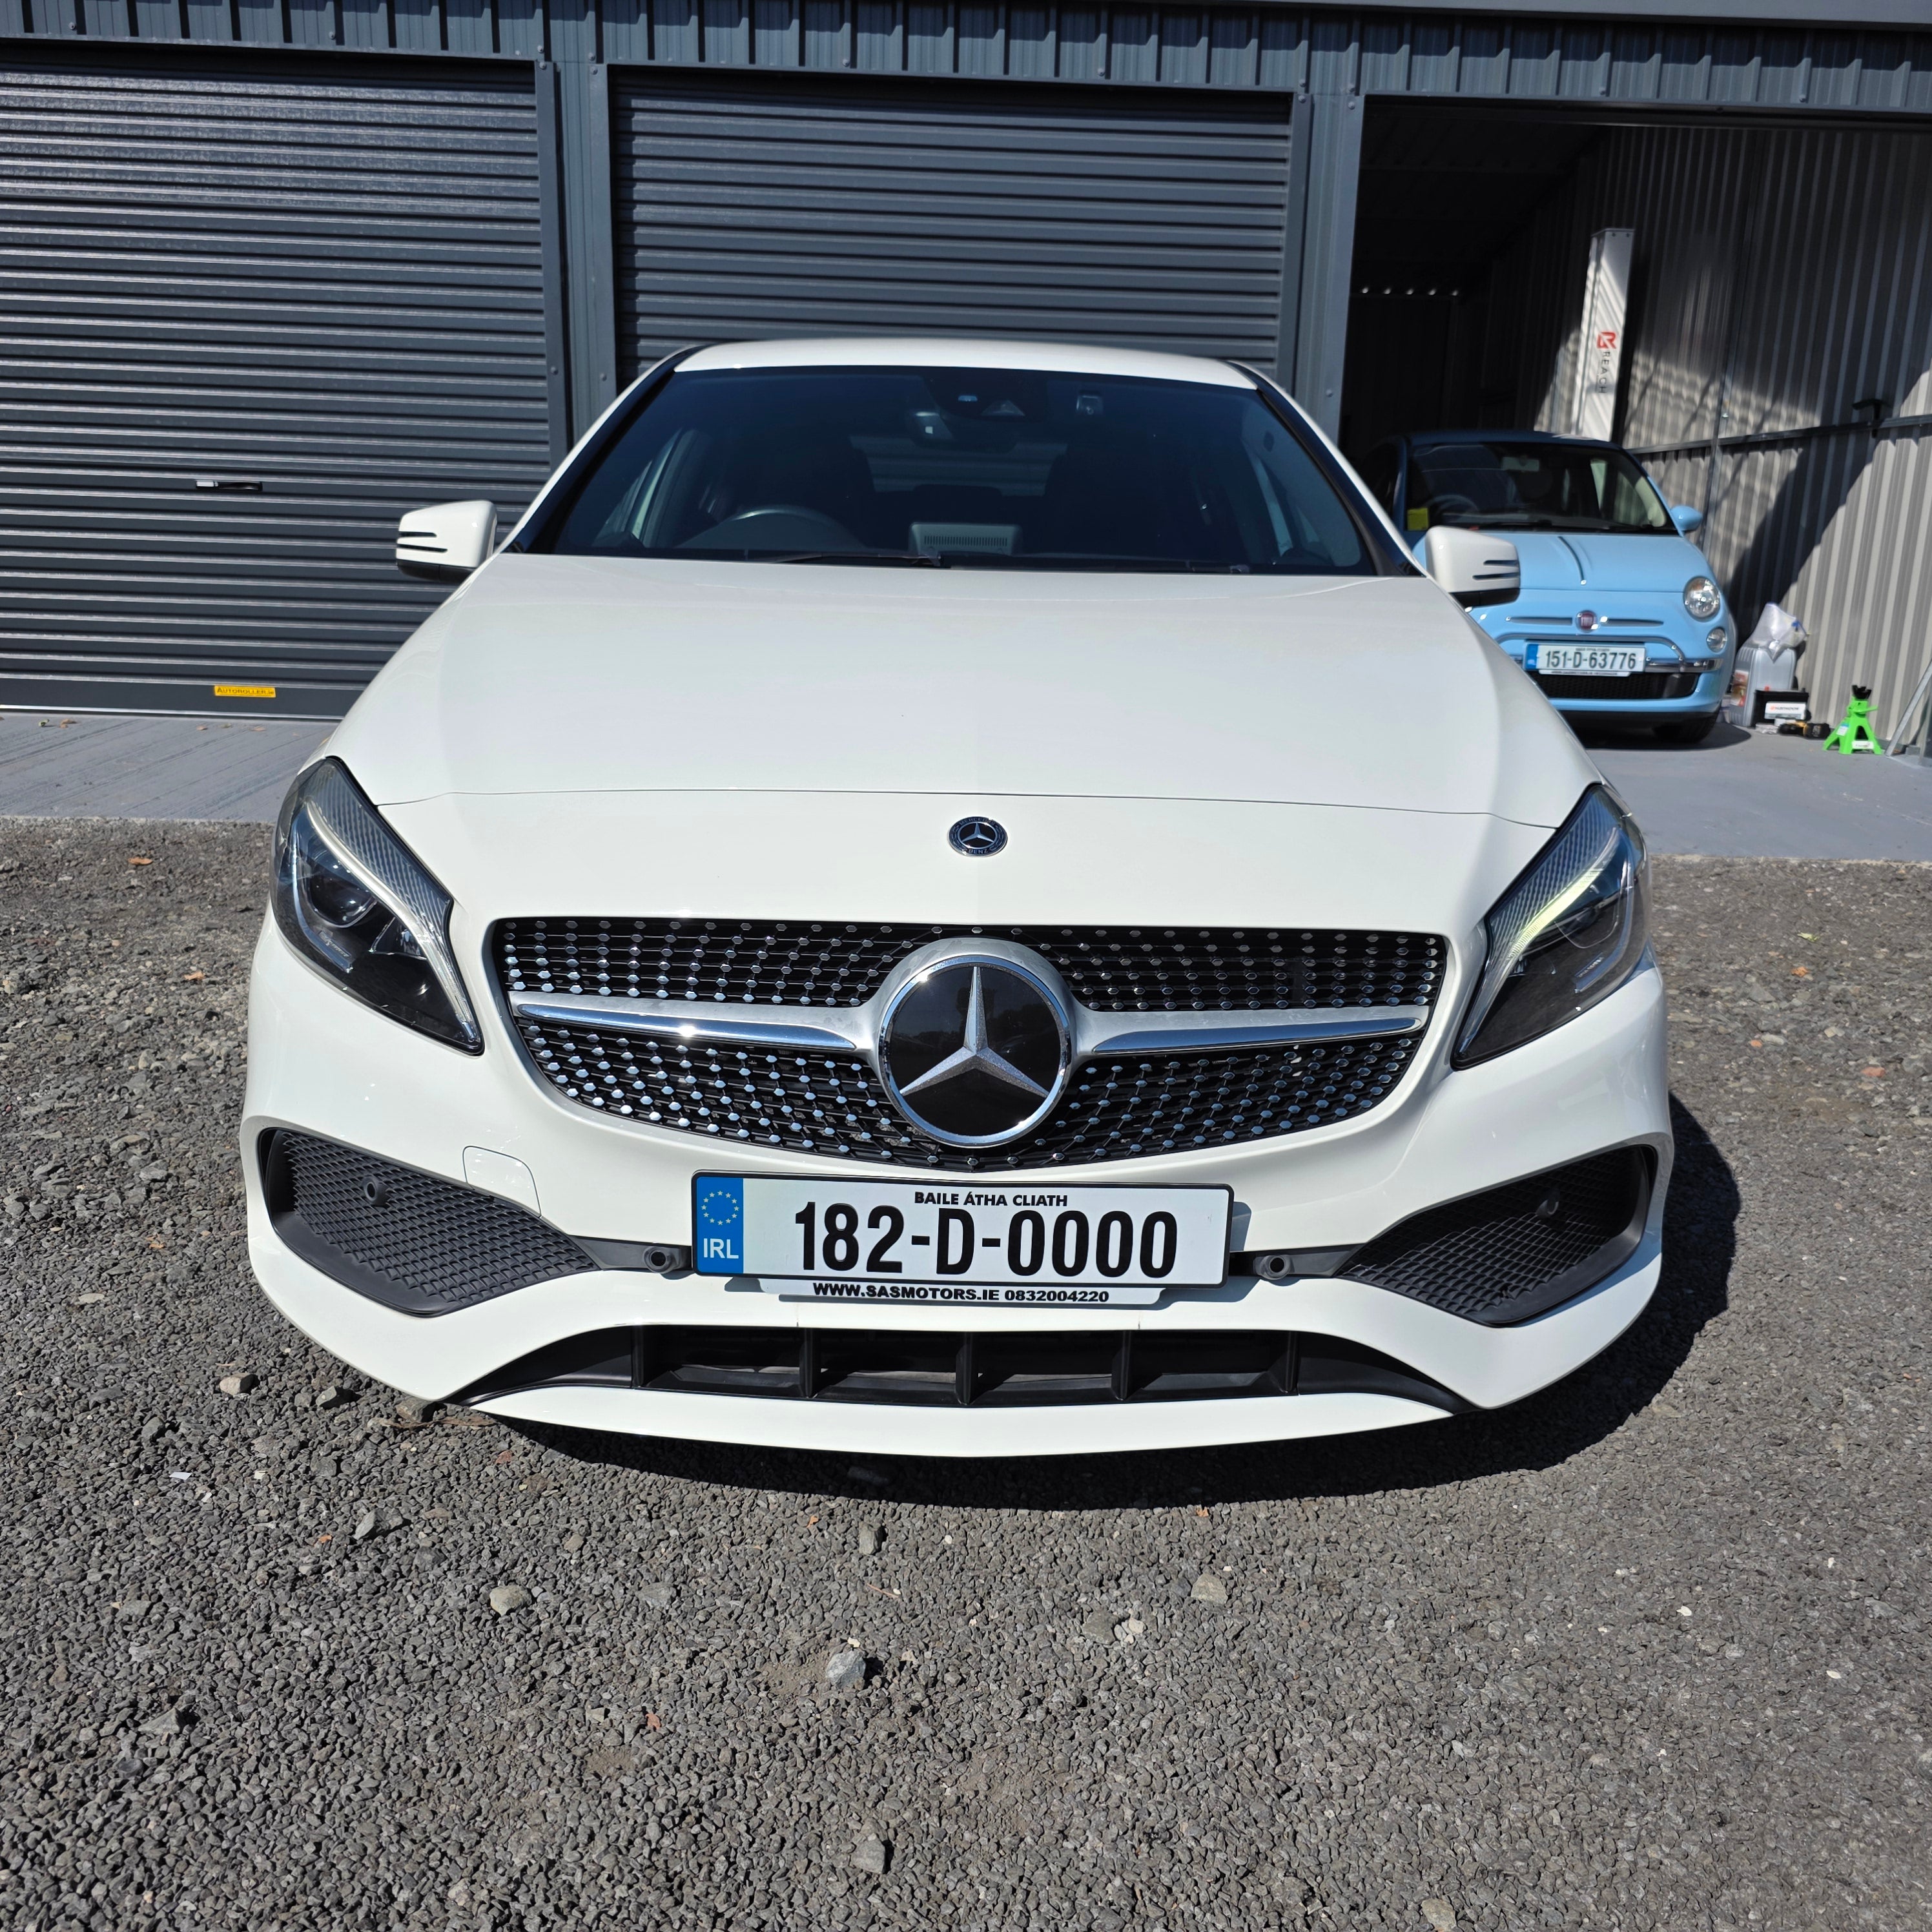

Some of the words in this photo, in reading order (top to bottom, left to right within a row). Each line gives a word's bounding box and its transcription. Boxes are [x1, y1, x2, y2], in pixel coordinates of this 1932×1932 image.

[1598, 351, 1610, 393] REACH
[1546, 651, 1636, 669] 151-D-63776
[914, 1191, 959, 1205] BAILE
[963, 1191, 1007, 1206] ÁTHA
[1012, 1195, 1067, 1206] CLIATH
[703, 1238, 739, 1259] IRL
[796, 1202, 1177, 1279] 182-D-0000
[813, 1282, 1000, 1300] WWW.SASMOTORS.IE
[1005, 1290, 1109, 1302] 0832004220
